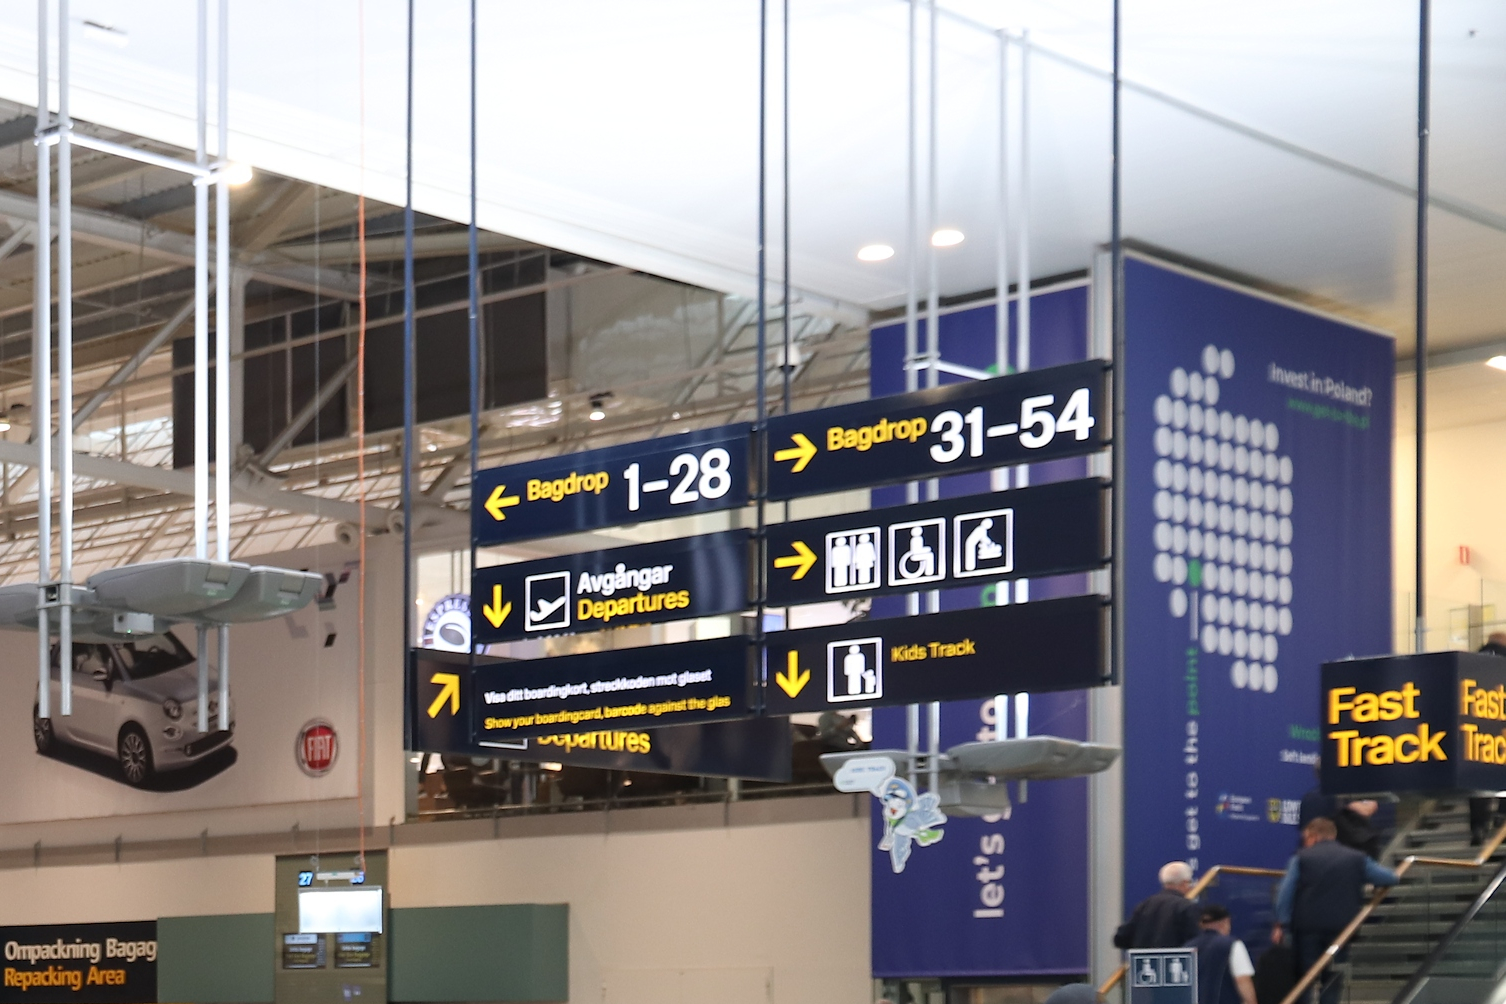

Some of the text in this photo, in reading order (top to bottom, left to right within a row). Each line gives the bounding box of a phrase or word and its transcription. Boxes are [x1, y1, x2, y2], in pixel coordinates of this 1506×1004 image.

[1268, 362, 1373, 407] Invest in Poland?
[827, 416, 927, 453] Bagdrop
[526, 469, 610, 503] Bagdrop
[577, 563, 673, 598] Avgångar
[577, 589, 690, 622] Departures
[891, 638, 976, 663] Kids Track
[484, 669, 712, 705] Visa ditt boardingkort, streckkoden mot glaset
[1328, 681, 1421, 725] Fast
[1460, 679, 1506, 722] Fast
[484, 716, 512, 730] Show
[512, 714, 535, 731] your
[535, 707, 604, 726] boardingcard,
[604, 703, 648, 720] barcode
[648, 701, 687, 718] against
[687, 697, 706, 712] the
[306, 735, 333, 762] FIAT
[1183, 721, 1199, 765] the
[1328, 723, 1448, 768] Track
[1460, 723, 1506, 765] Trac
[1185, 772, 1199, 799] to
[298, 872, 314, 886] 27
[973, 833, 1005, 918] let's
[4, 938, 157, 963] Ompackning Bagag
[4, 966, 125, 990] Repacking Area
